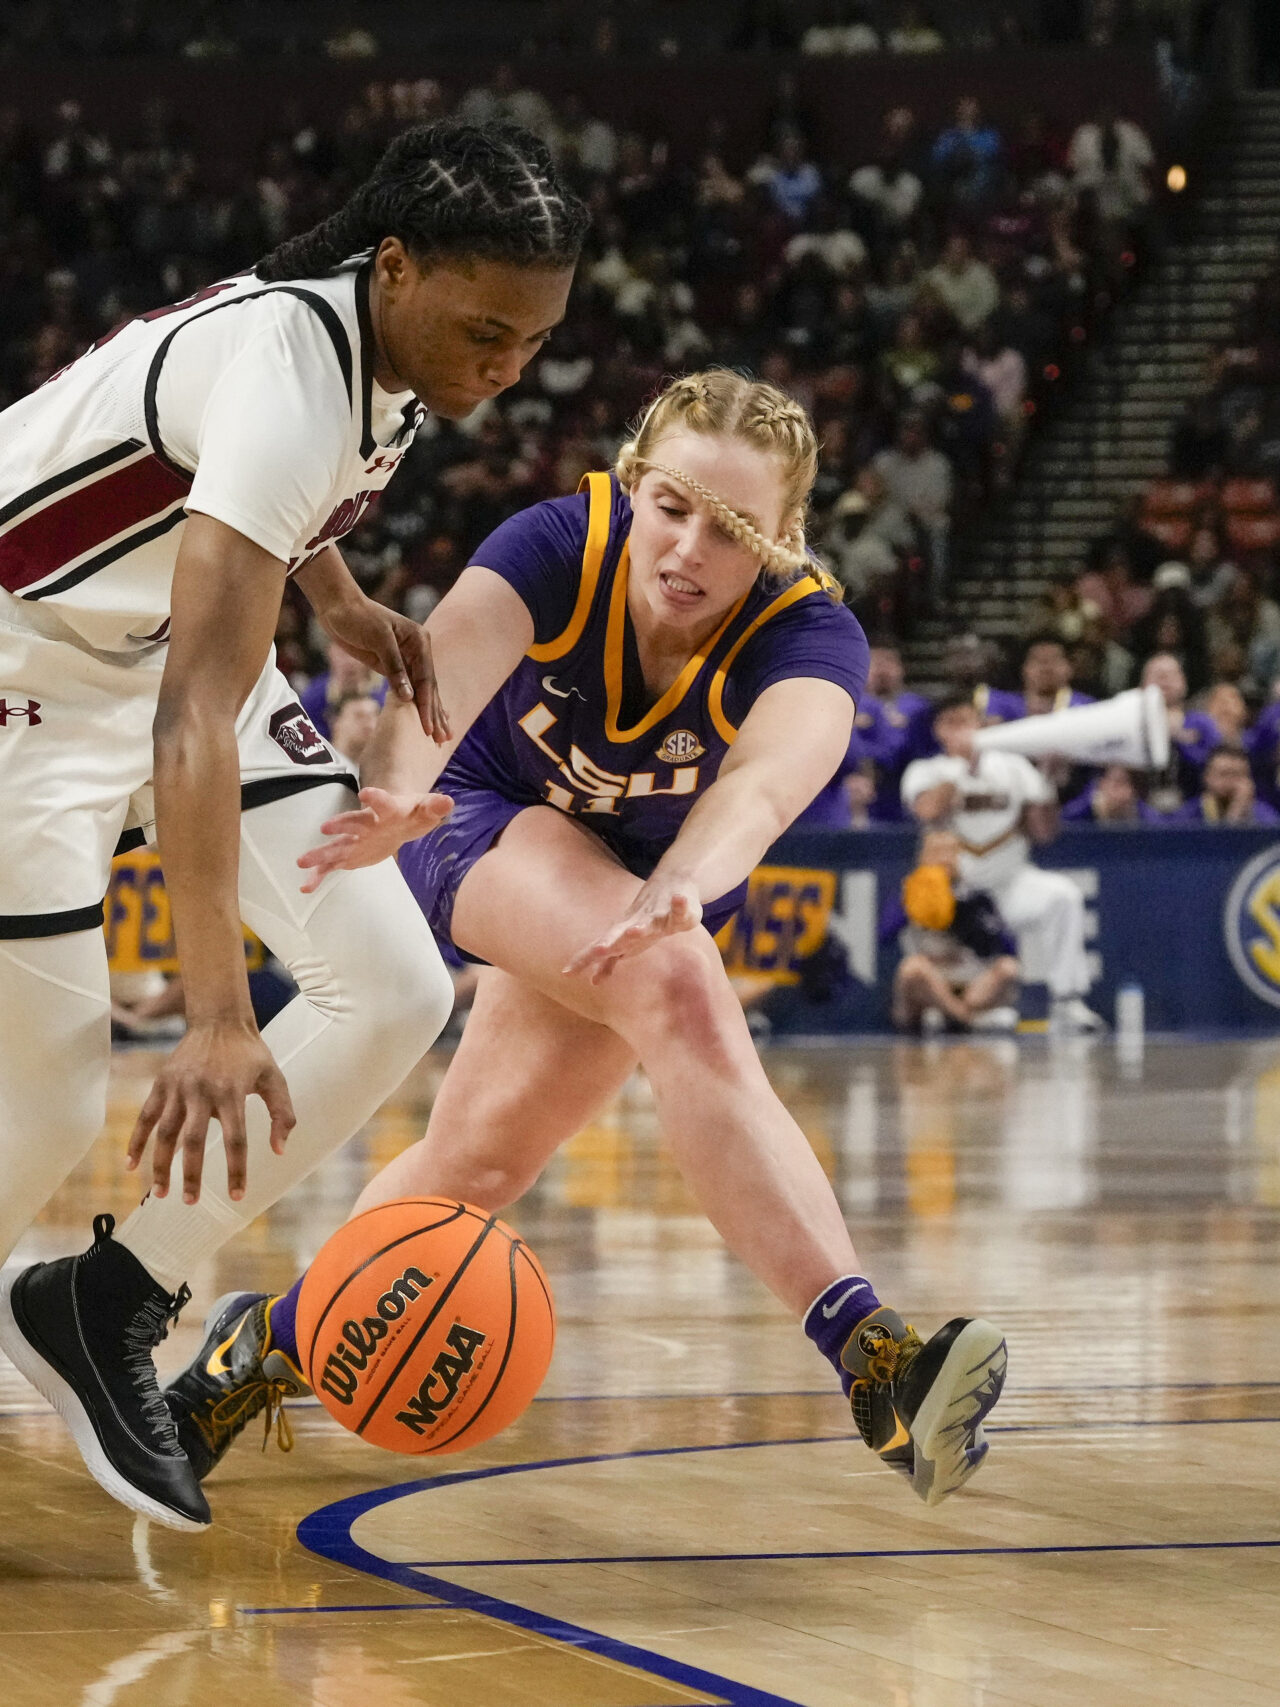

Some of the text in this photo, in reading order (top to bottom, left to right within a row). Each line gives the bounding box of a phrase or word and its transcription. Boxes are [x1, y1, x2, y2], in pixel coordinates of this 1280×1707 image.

[517, 701, 700, 799] LSU
[666, 732, 697, 756] SEC
[320, 1265, 436, 1406] Wilson
[394, 1322, 488, 1436] NCAA
[456, 1372, 480, 1405] GAME
[476, 1338, 496, 1371] BALL
